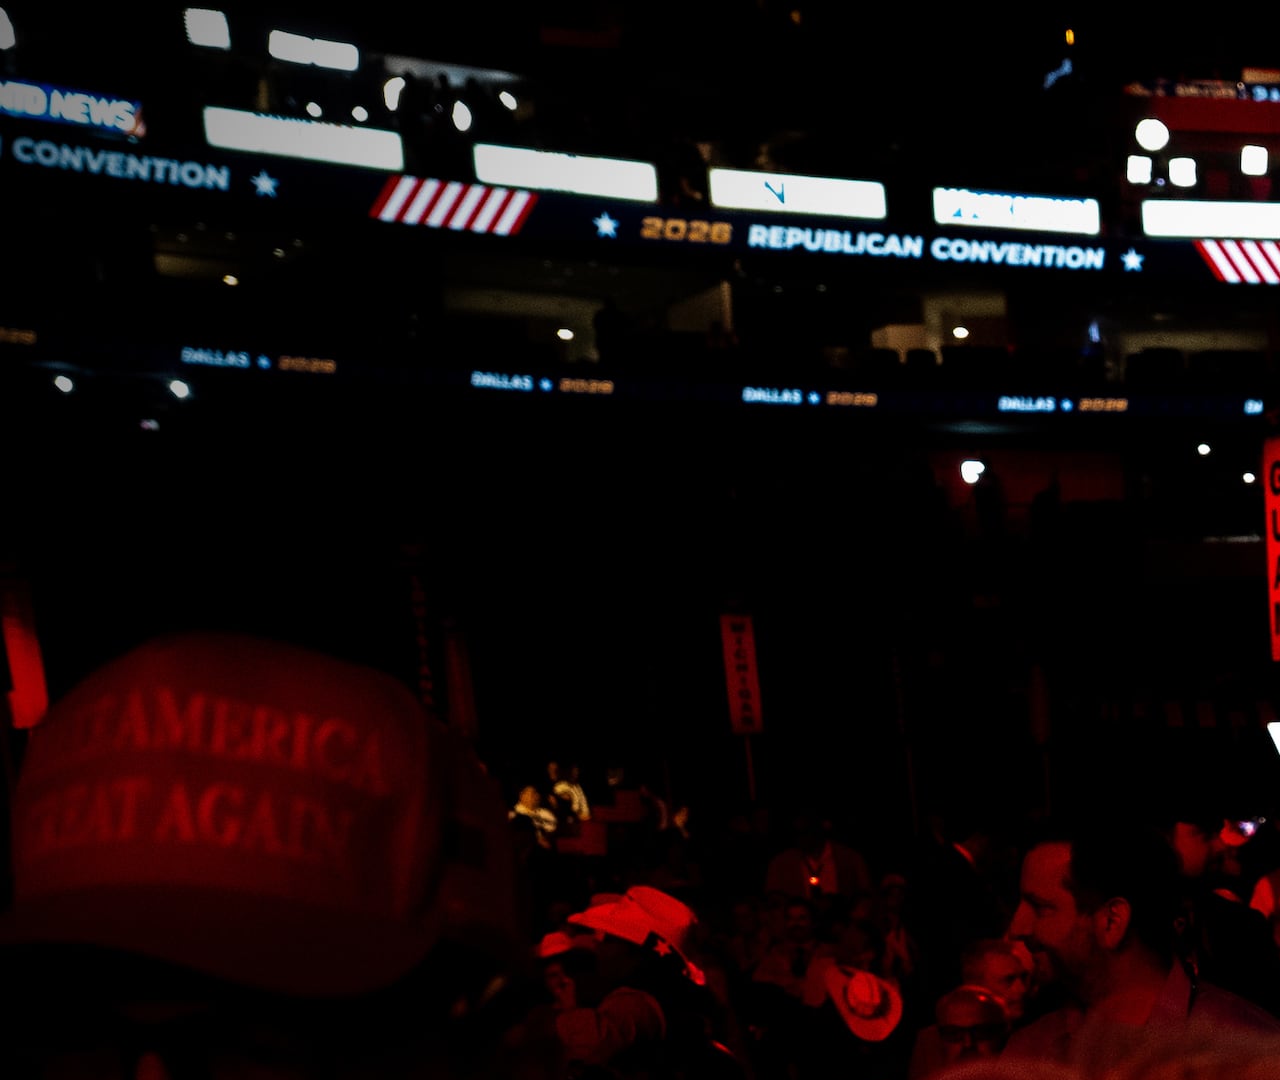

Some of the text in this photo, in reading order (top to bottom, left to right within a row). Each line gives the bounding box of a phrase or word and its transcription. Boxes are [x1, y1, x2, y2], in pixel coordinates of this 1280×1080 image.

[50, 89, 137, 132] NEWS
[12, 134, 231, 192] CONVENTION
[641, 216, 1104, 270] 2026 REPUBLICAN CONVENTION
[113, 687, 391, 797] AMERICA
